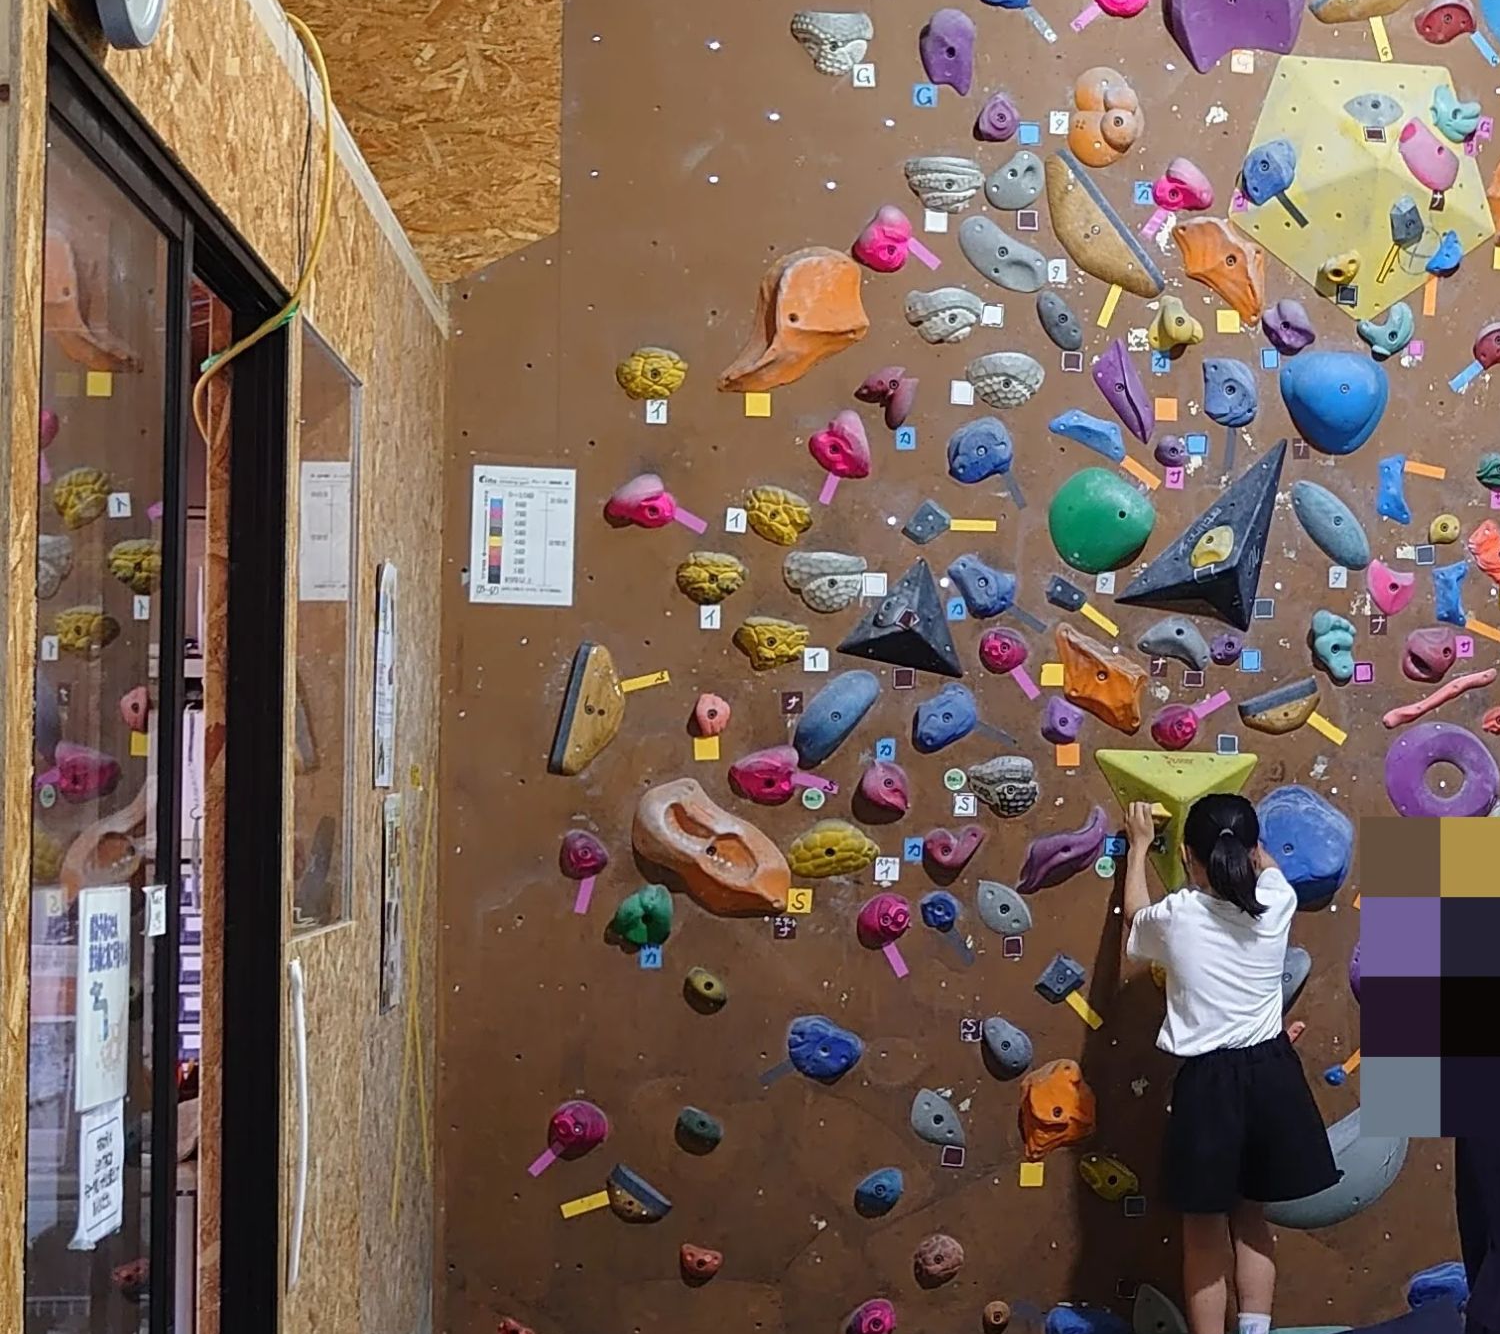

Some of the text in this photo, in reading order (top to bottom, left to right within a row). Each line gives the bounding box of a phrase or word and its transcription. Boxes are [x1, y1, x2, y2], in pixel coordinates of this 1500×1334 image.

[856, 67, 871, 84] G
[916, 87, 932, 105] G
[1432, 190, 1443, 208] ナ
[900, 432, 911, 445] カ
[1169, 470, 1181, 484] サ
[730, 513, 741, 528] イ
[705, 610, 716, 625] イ
[1371, 617, 1385, 634] ナ
[1460, 641, 1471, 652] サ
[808, 652, 820, 668] イ
[1152, 657, 1167, 674] ナ
[787, 695, 800, 709] ナ
[880, 744, 892, 757] カ
[824, 780, 835, 792] S
[958, 797, 970, 812] S
[908, 843, 920, 857] カ
[1110, 839, 1121, 852] S
[880, 866, 891, 879] イ
[792, 893, 806, 910] S
[645, 951, 657, 965] カ
